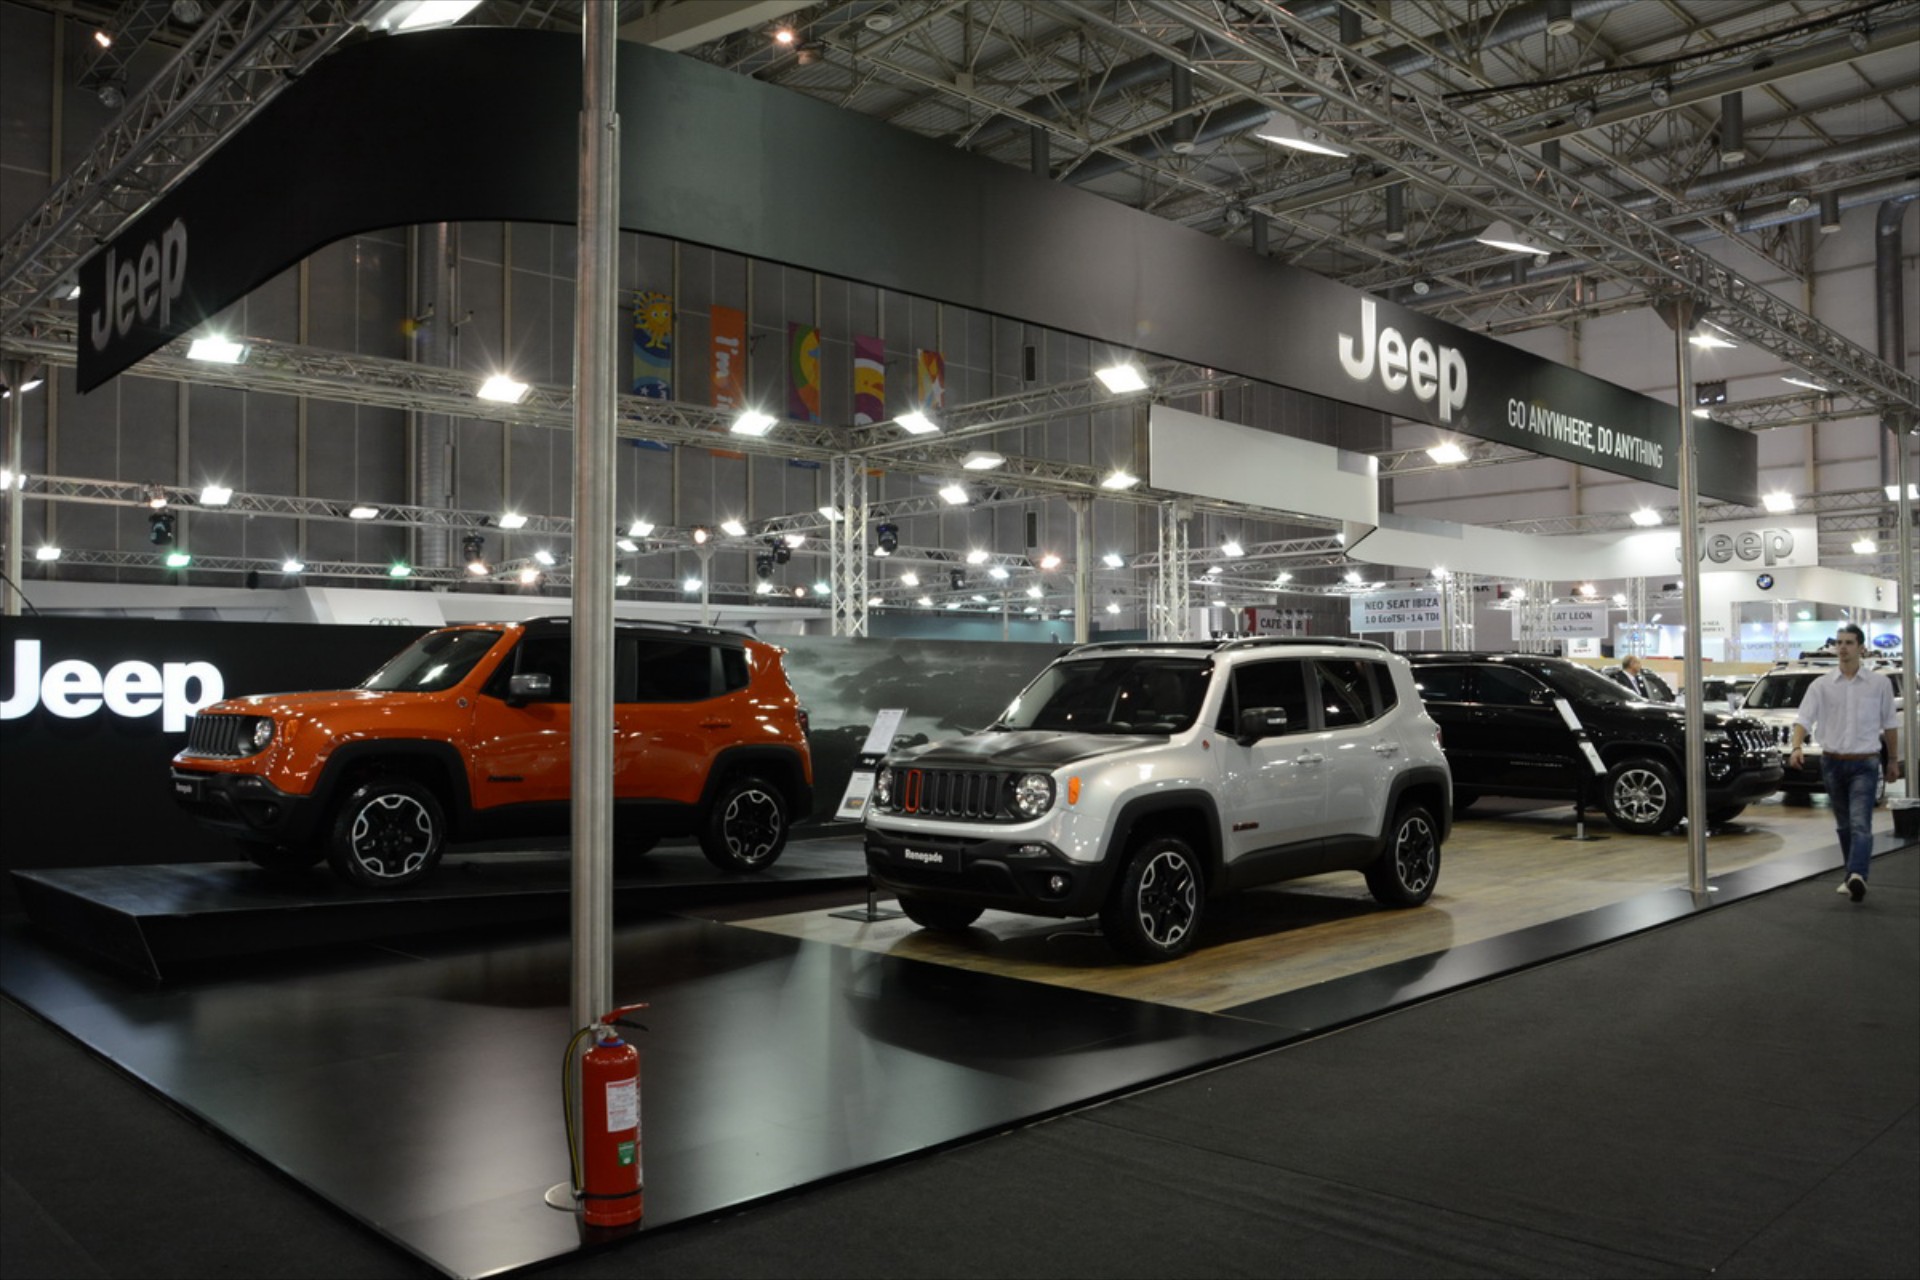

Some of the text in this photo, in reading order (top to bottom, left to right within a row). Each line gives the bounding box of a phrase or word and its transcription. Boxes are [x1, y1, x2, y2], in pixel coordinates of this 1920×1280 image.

[91, 217, 188, 350] Jeep
[1338, 297, 1468, 422] Jeep
[1507, 398, 1664, 469] GO ANYWHERE, DO ANYTHING
[1364, 598, 1439, 611] NEO SEAT IBIZA
[0, 639, 225, 733] Jeep
[904, 848, 944, 864] Renegade
